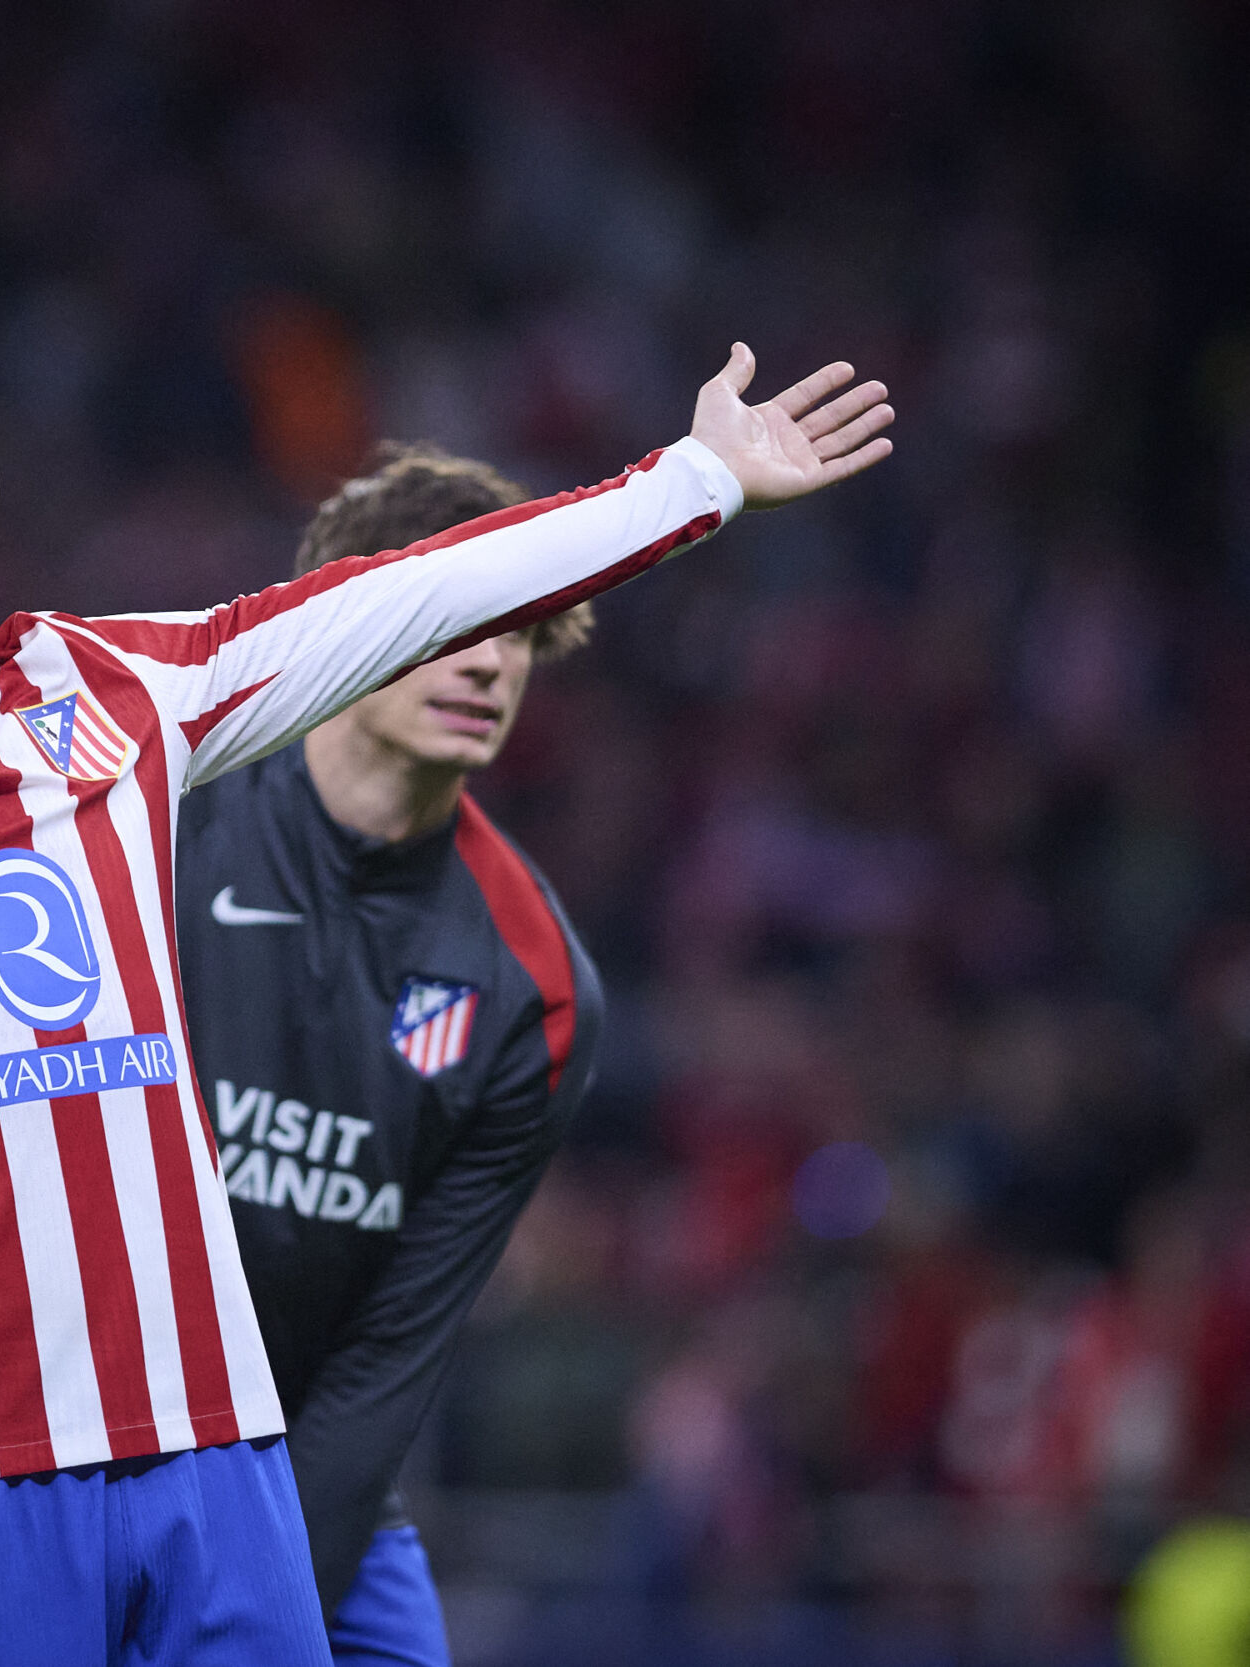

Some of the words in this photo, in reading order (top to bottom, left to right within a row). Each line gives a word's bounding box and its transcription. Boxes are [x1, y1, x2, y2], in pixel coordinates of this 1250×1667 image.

[120, 1040, 174, 1081] AIR
[215, 1079, 374, 1168] VISIT
[218, 1143, 404, 1231] ANDA
